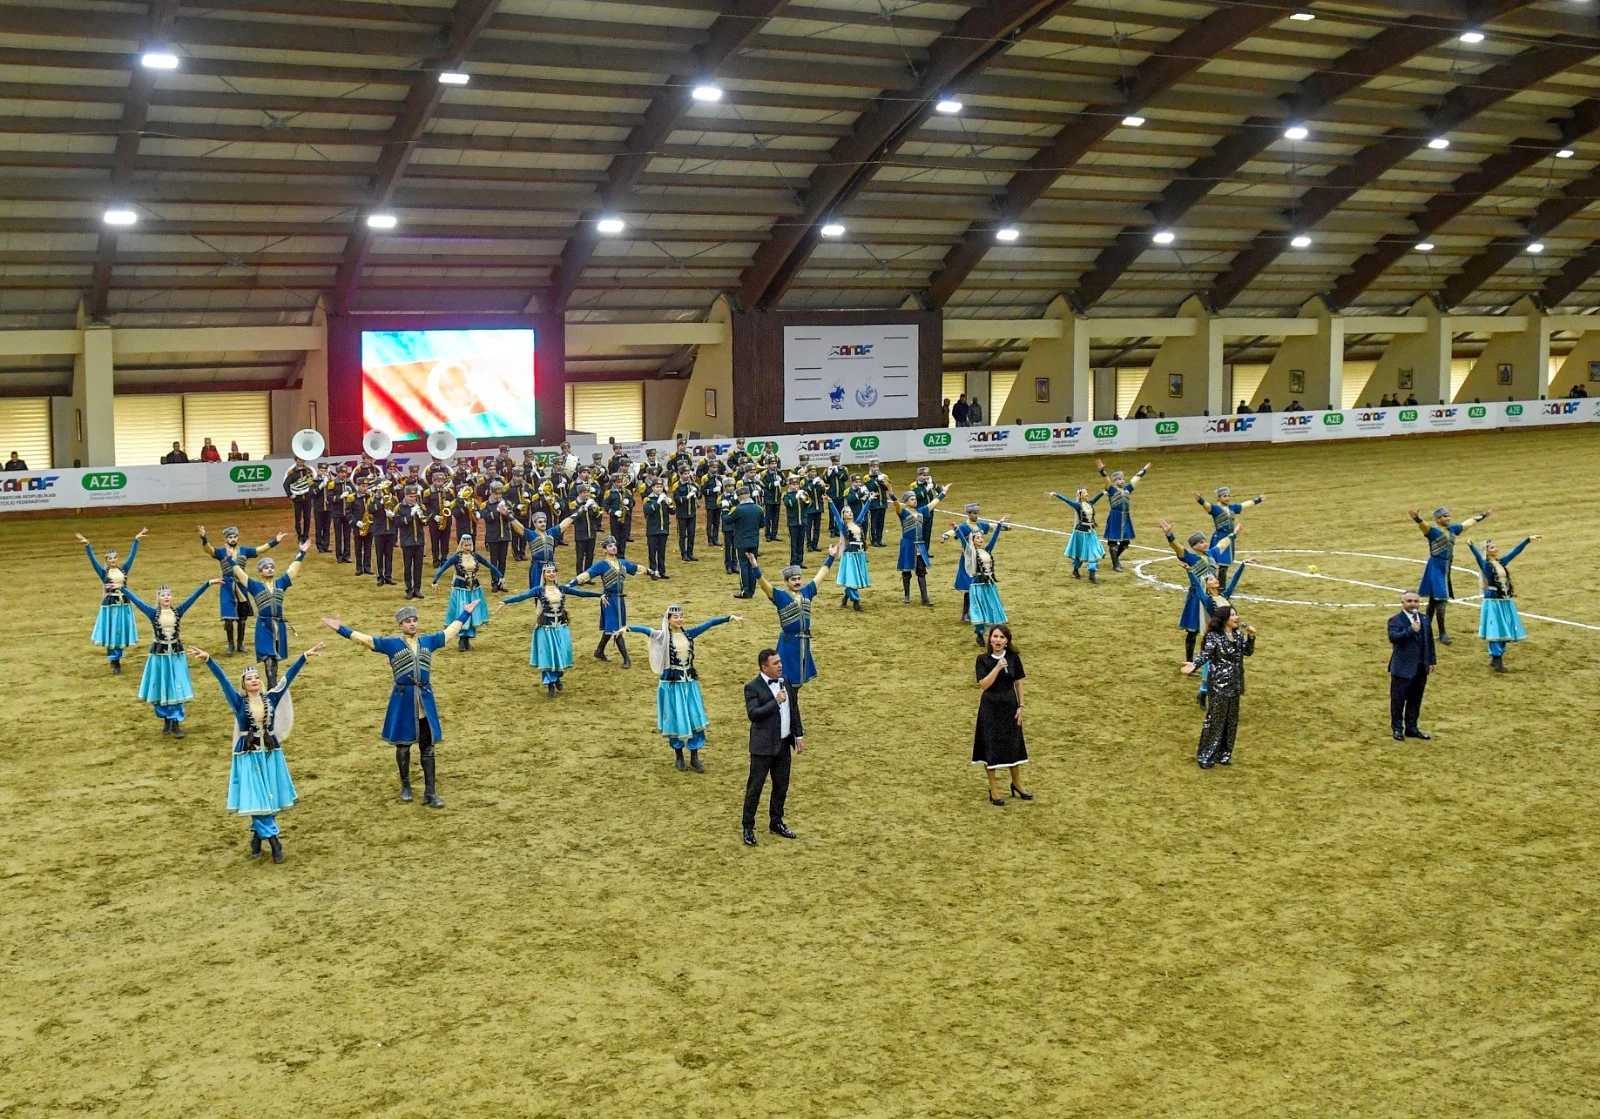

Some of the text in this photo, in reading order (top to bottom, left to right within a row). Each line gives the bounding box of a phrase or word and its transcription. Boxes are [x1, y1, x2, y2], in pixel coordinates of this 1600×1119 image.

[1470, 407, 1484, 417] AZE
[1508, 405, 1521, 415] AZE
[1326, 414, 1341, 424] AZE
[1401, 411, 1415, 421] AZE
[1097, 426, 1114, 437] AZE
[1159, 423, 1175, 433] AZE
[928, 434, 947, 445] AZE
[1028, 429, 1047, 440] AZE
[855, 438, 875, 449] AZE
[237, 467, 265, 480] AZE
[90, 475, 120, 488] AZE
